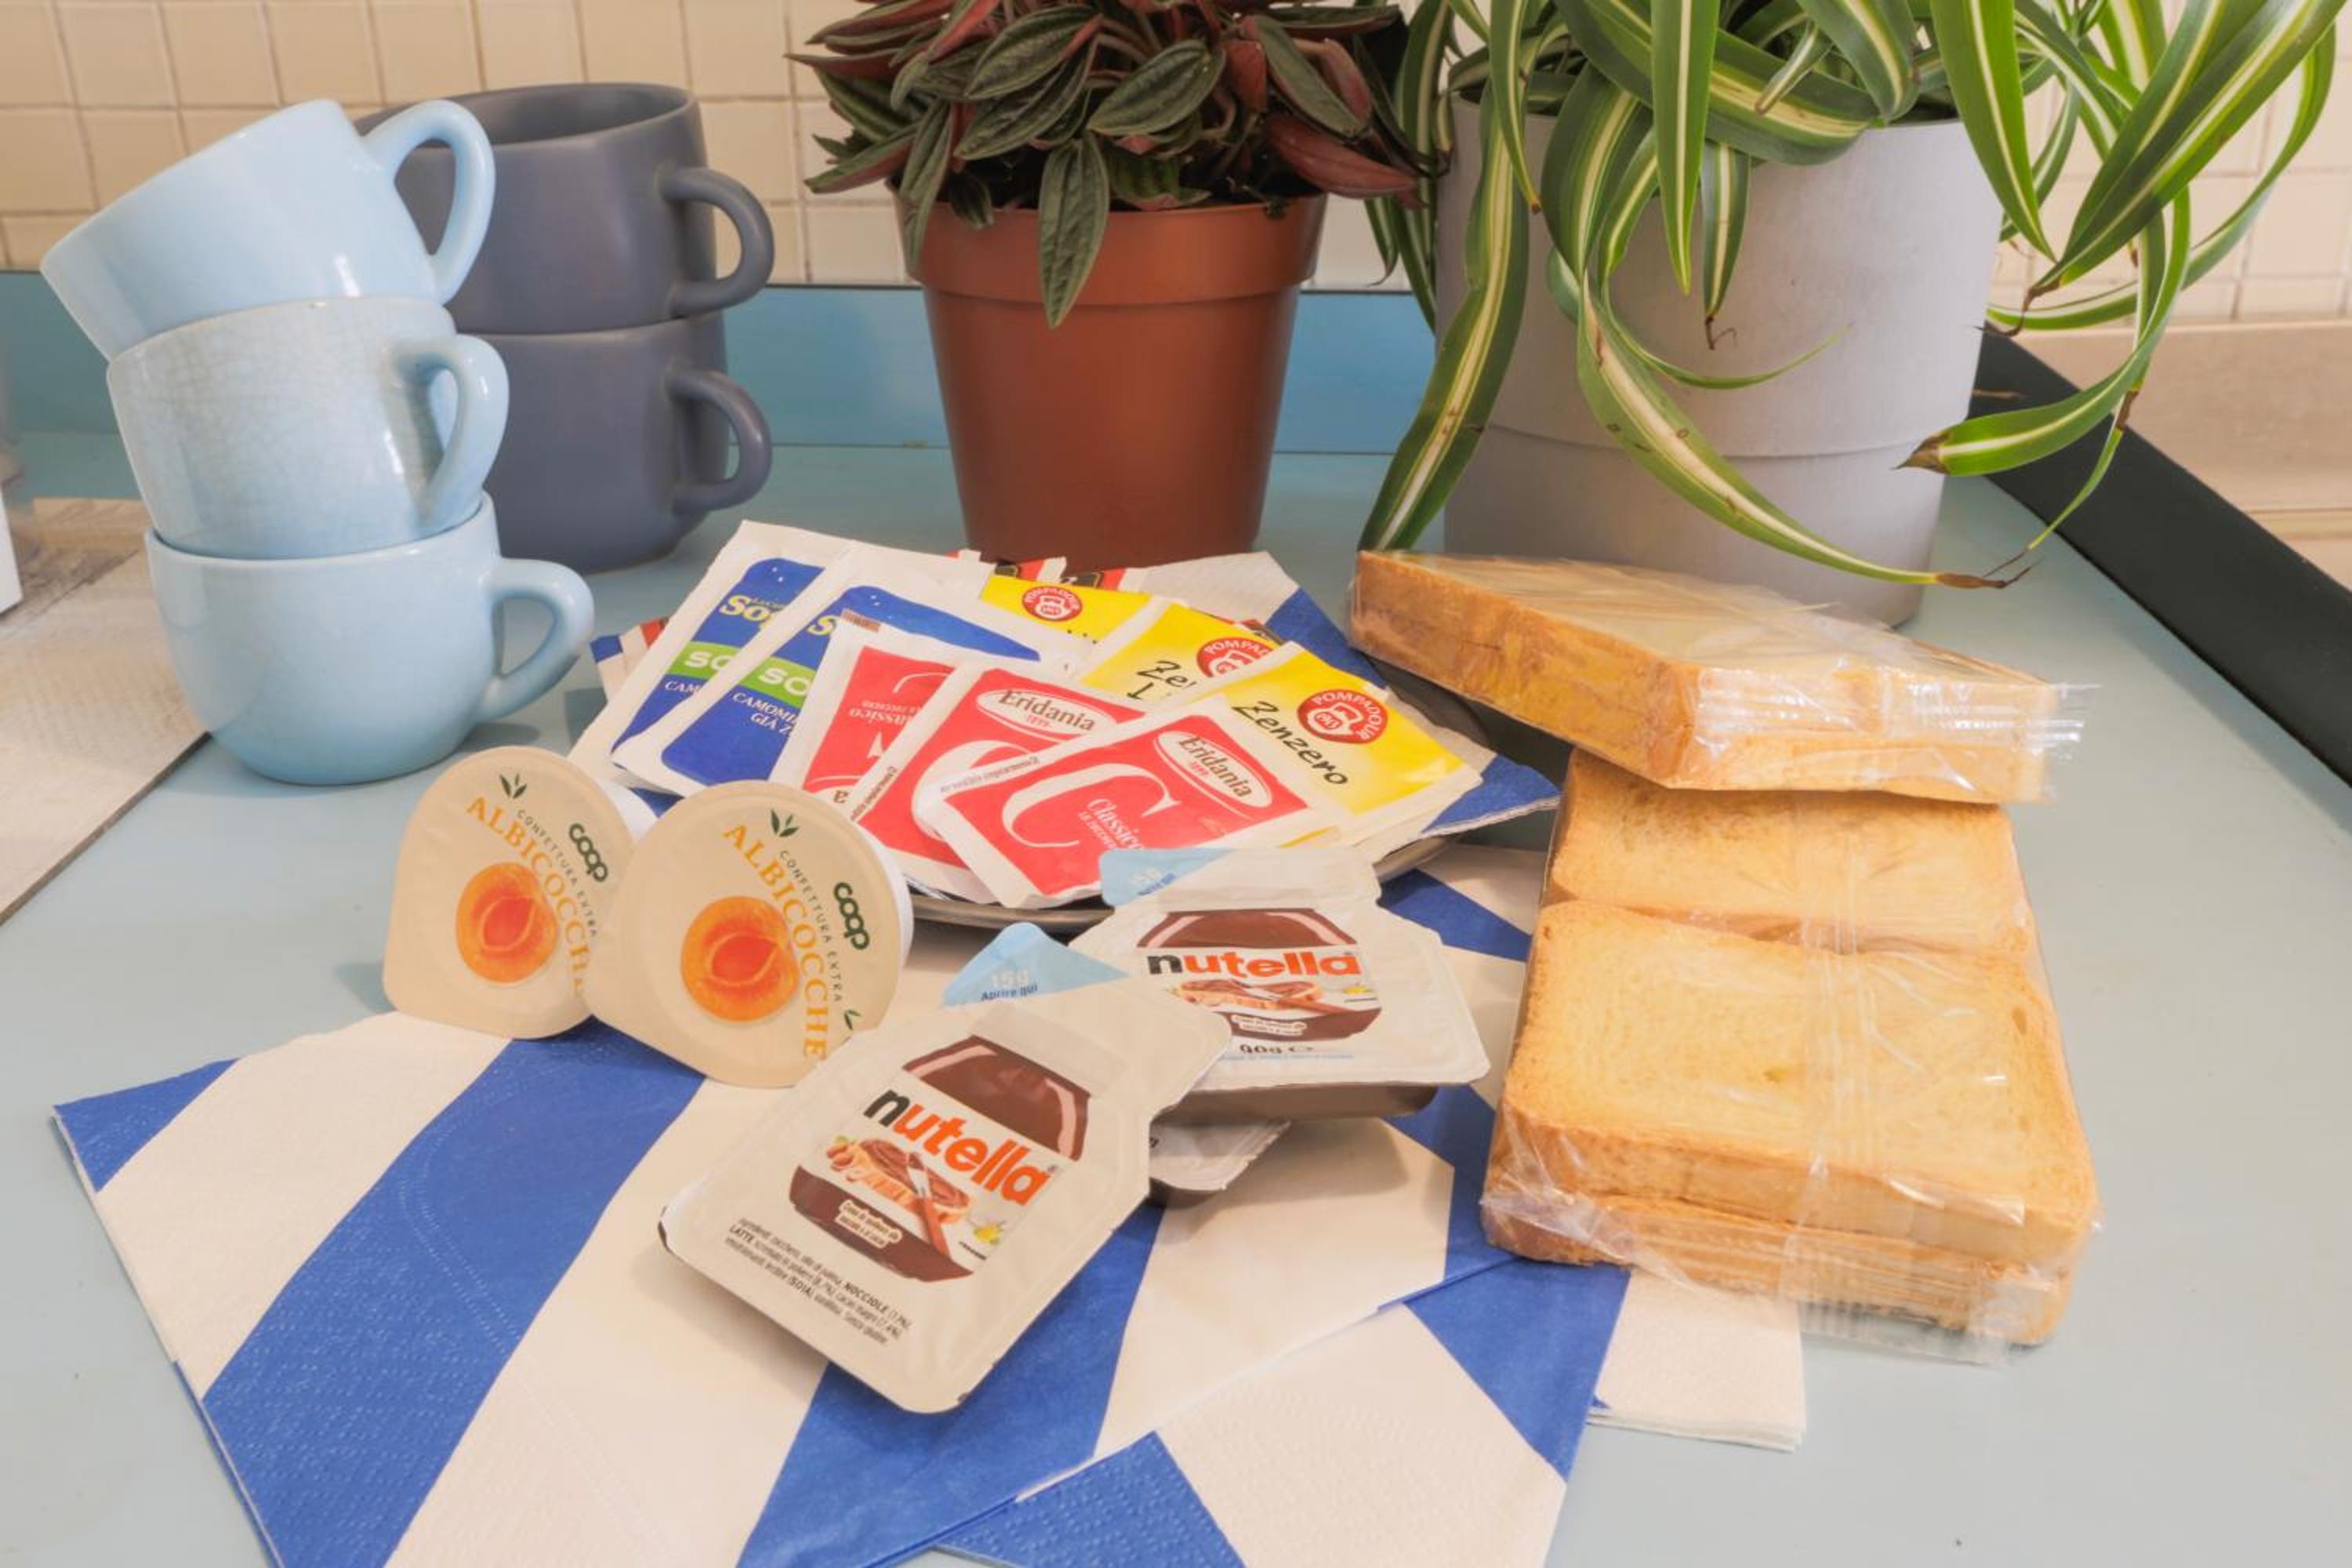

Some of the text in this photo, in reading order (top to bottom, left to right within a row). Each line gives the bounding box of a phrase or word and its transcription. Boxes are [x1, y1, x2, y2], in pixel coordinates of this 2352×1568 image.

[999, 690, 1094, 731] Eridania
[1231, 700, 1348, 785] Zenzero
[1311, 692, 1382, 741] POMPADOUR
[1178, 737, 1252, 797] Eridania
[568, 823, 608, 882] coop
[722, 825, 829, 1061] ALBICOCCHE
[779, 849, 844, 1004] CONFETTURA EXTRA
[833, 881, 870, 950] coop
[1147, 951, 1363, 979] nutella
[862, 1089, 1051, 1206] nutella
